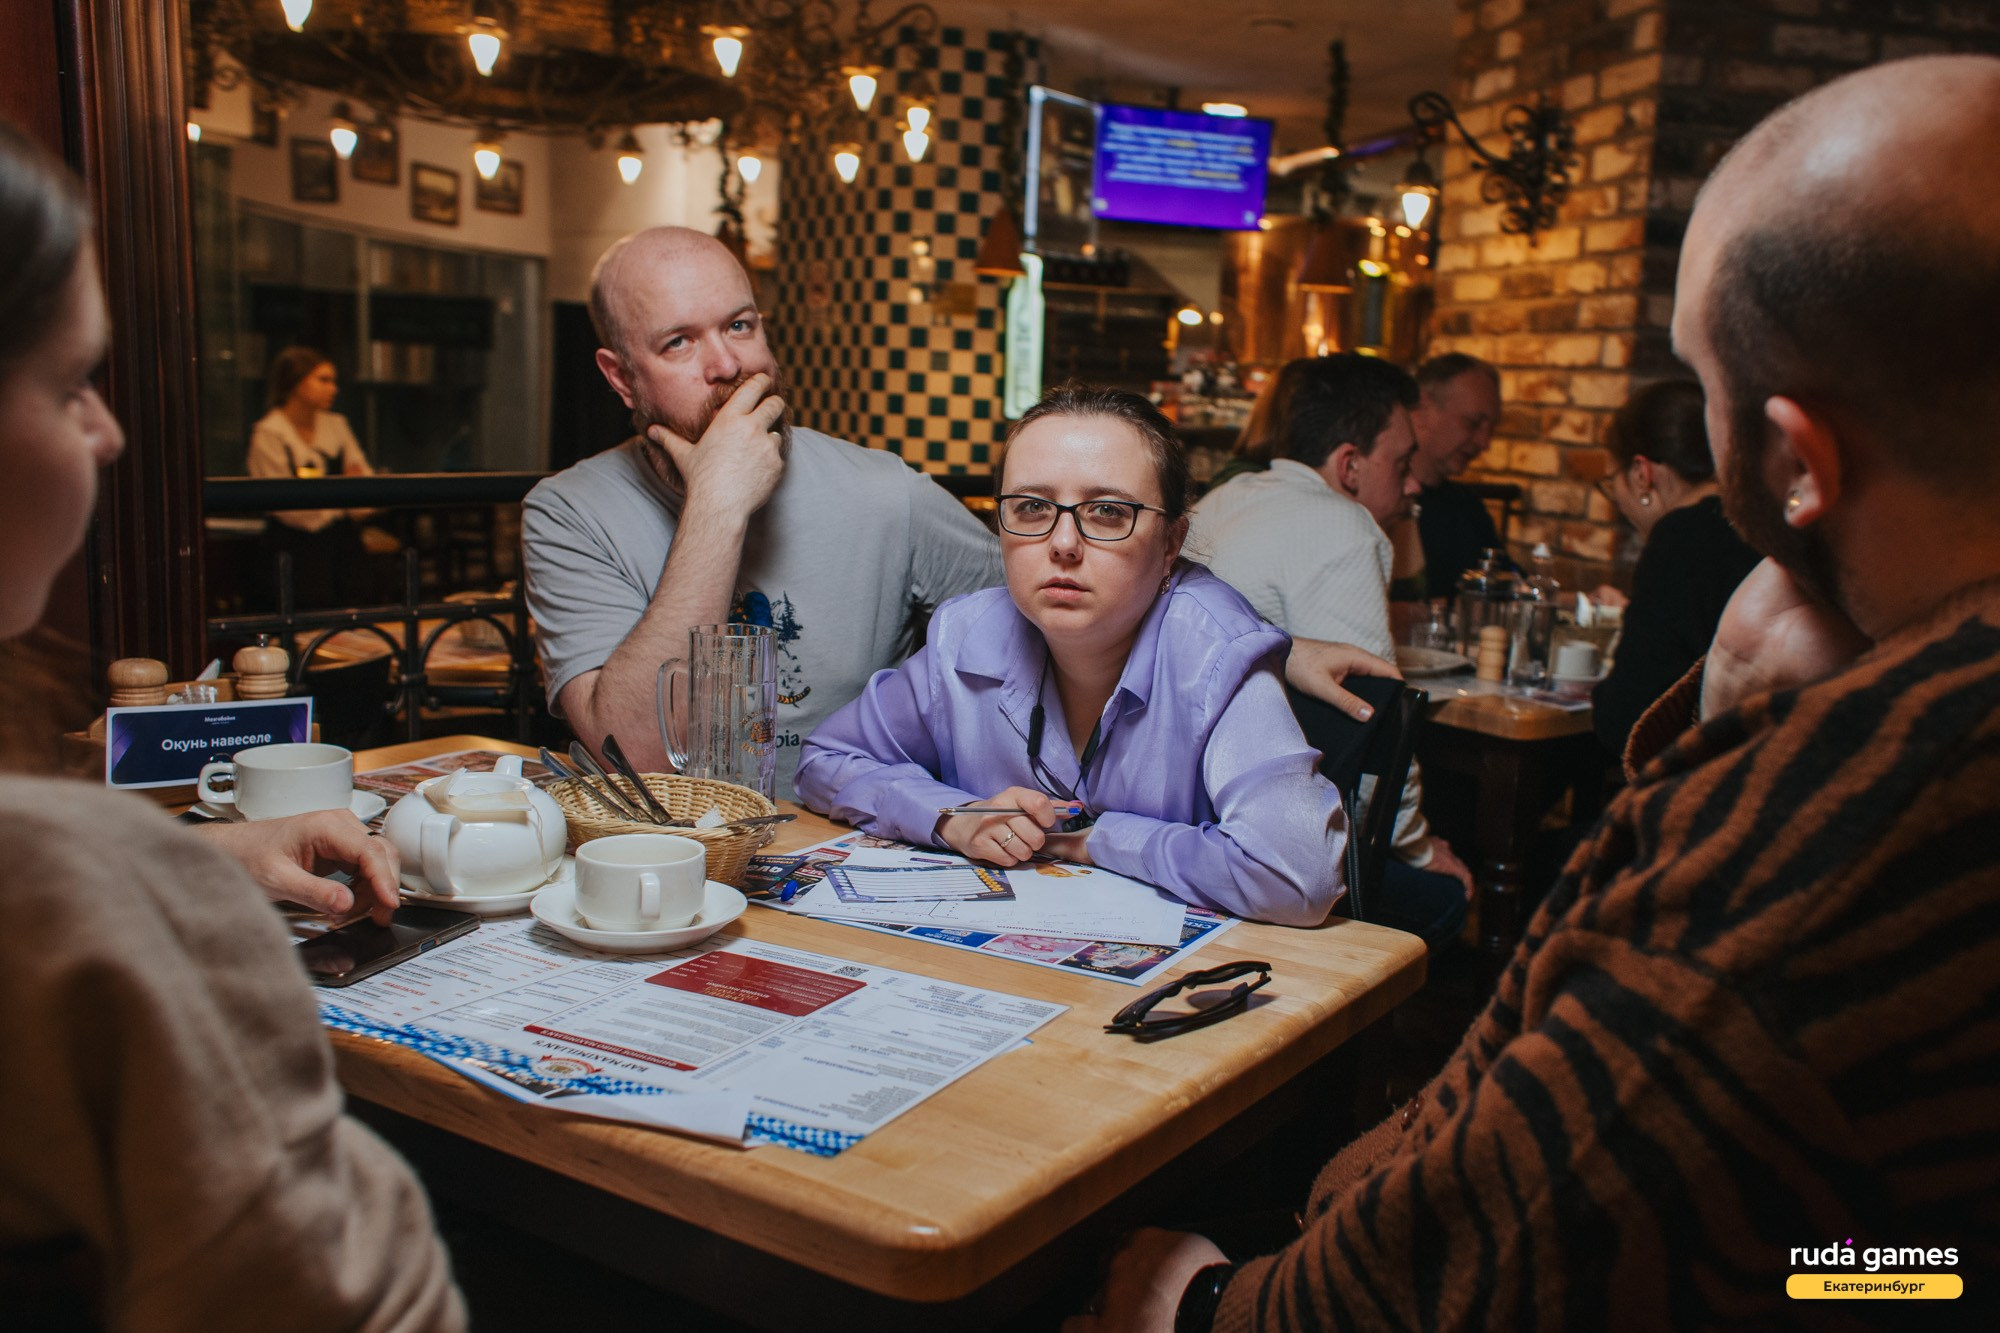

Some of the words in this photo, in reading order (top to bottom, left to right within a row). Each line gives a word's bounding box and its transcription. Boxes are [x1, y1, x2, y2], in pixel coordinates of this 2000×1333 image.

[161, 737, 208, 753] Окунь
[211, 733, 272, 748] навеселе
[539, 1028, 598, 1047] MAXIMILIAN'S
[532, 1040, 620, 1067] MAXIMILIAN'S
[598, 1043, 622, 1054] ПИВО
[621, 1049, 677, 1067] ФИРМЕННОЕ
[621, 1059, 648, 1073] БАР
